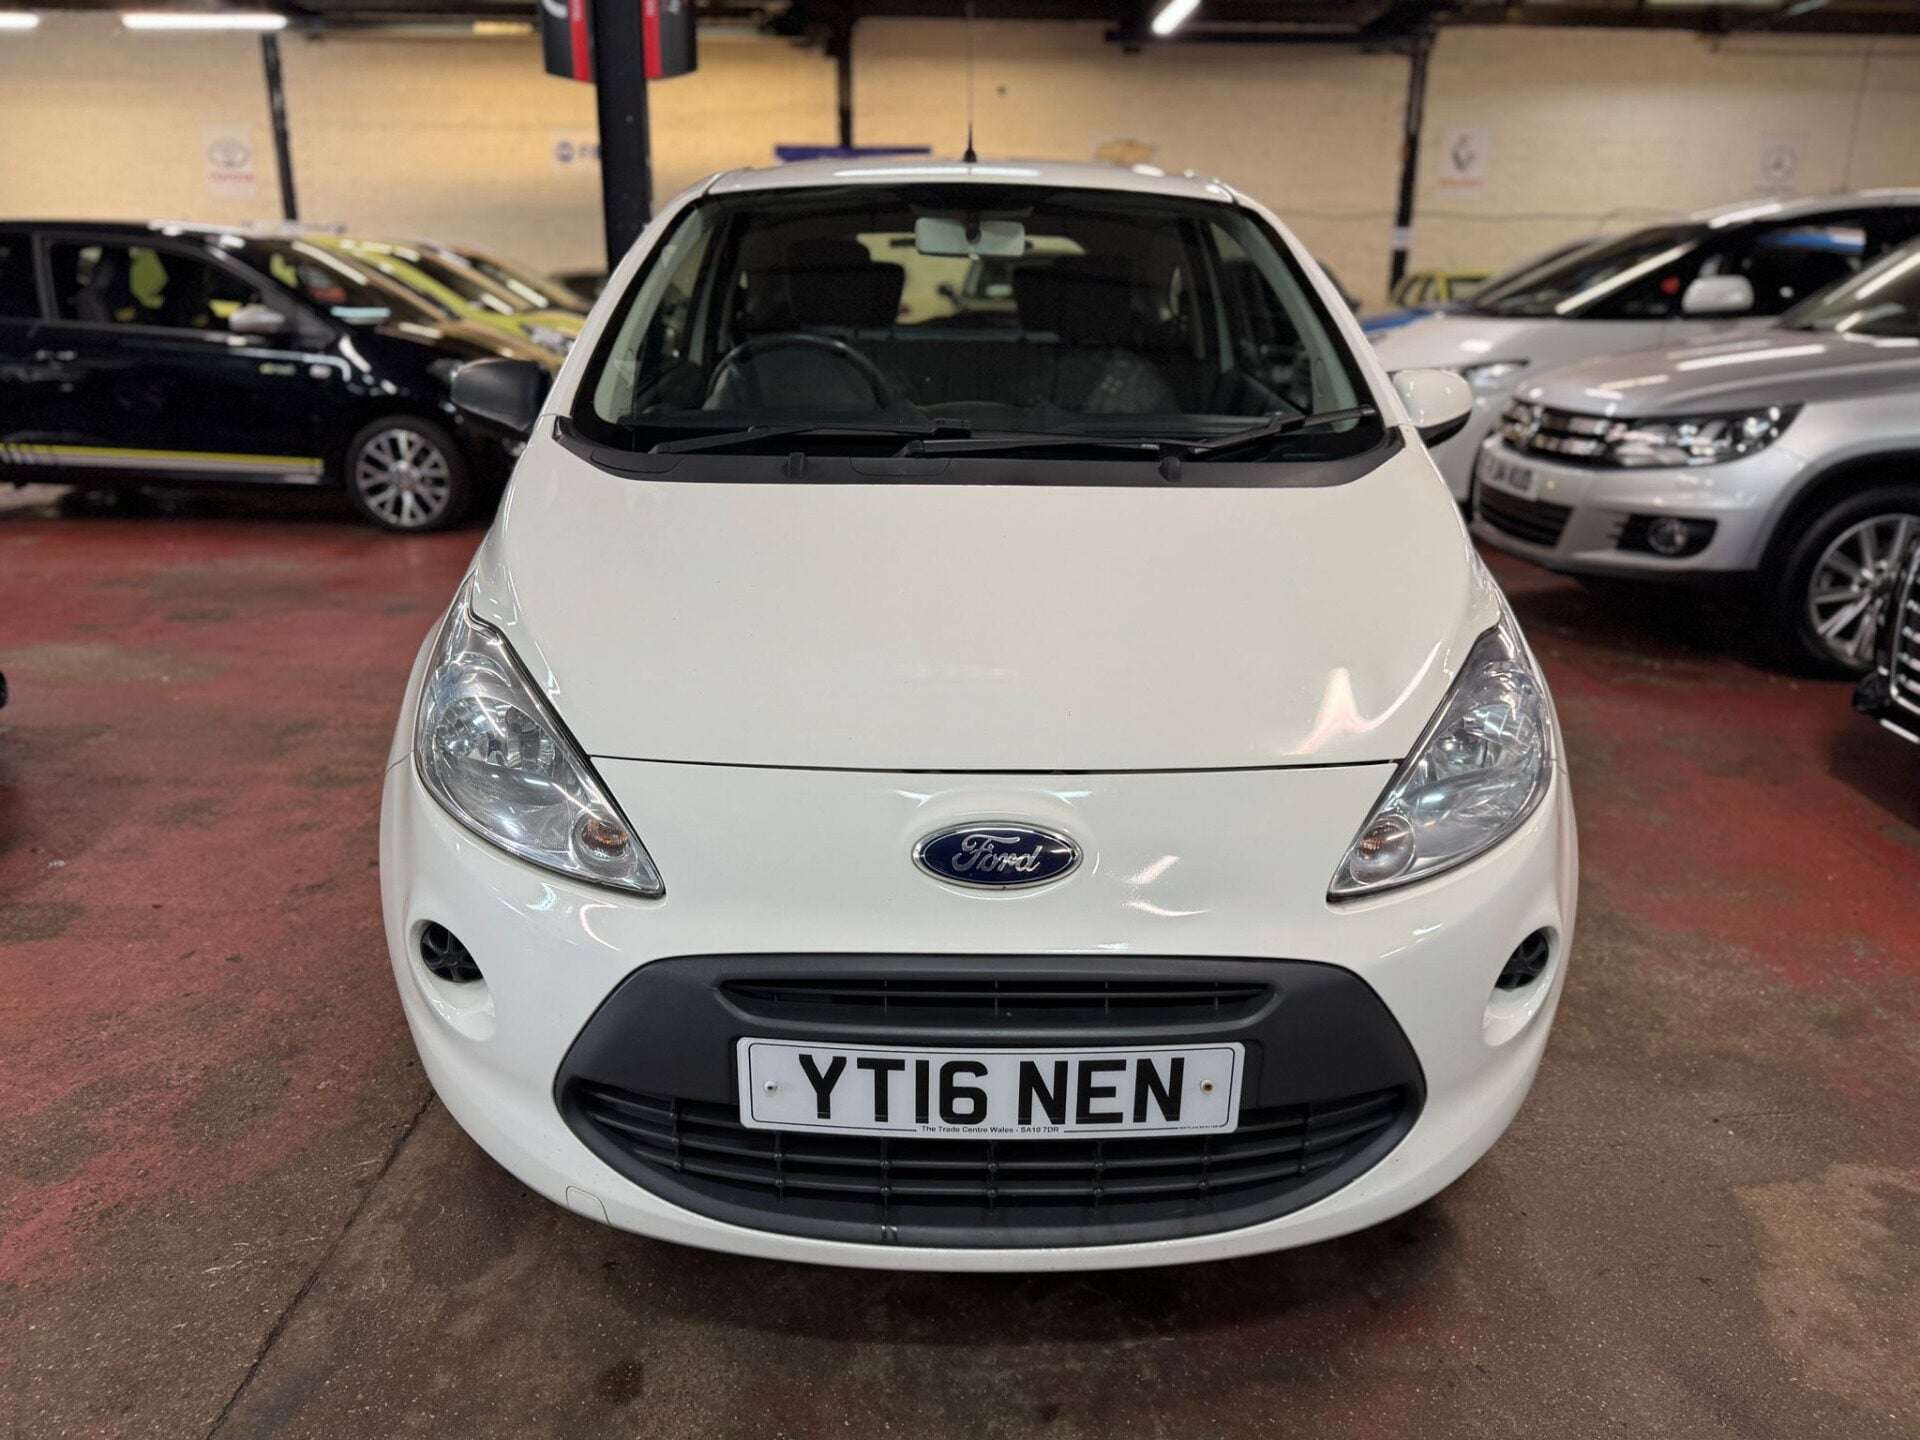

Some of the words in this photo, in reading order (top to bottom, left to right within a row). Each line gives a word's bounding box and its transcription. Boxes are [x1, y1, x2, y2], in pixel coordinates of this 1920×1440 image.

[952, 833, 1043, 872] Ford
[799, 1054, 989, 1125] YT16
[1017, 1057, 1185, 1125] NEN
[962, 1126, 988, 1134] Centre
[989, 1126, 1014, 1134] Wales
[1042, 1126, 1060, 1134] 7DR
